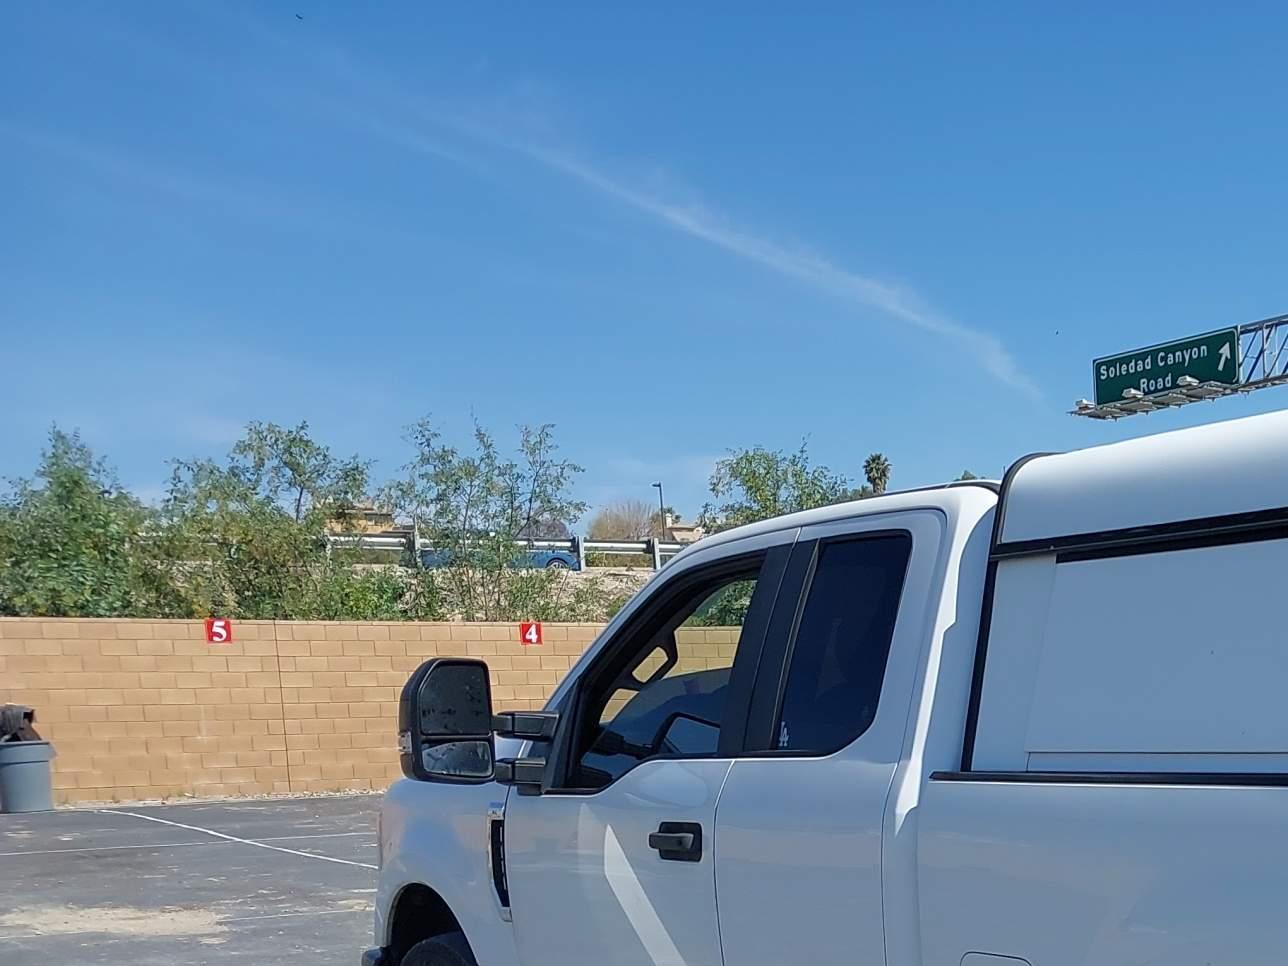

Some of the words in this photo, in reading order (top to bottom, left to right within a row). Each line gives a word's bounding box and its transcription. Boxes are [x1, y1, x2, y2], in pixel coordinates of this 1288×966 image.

[1100, 356, 1152, 380] Soledad
[1158, 345, 1208, 367] Canyon
[1140, 374, 1172, 393] Road
[212, 620, 227, 642] 5
[525, 624, 538, 643] 4
